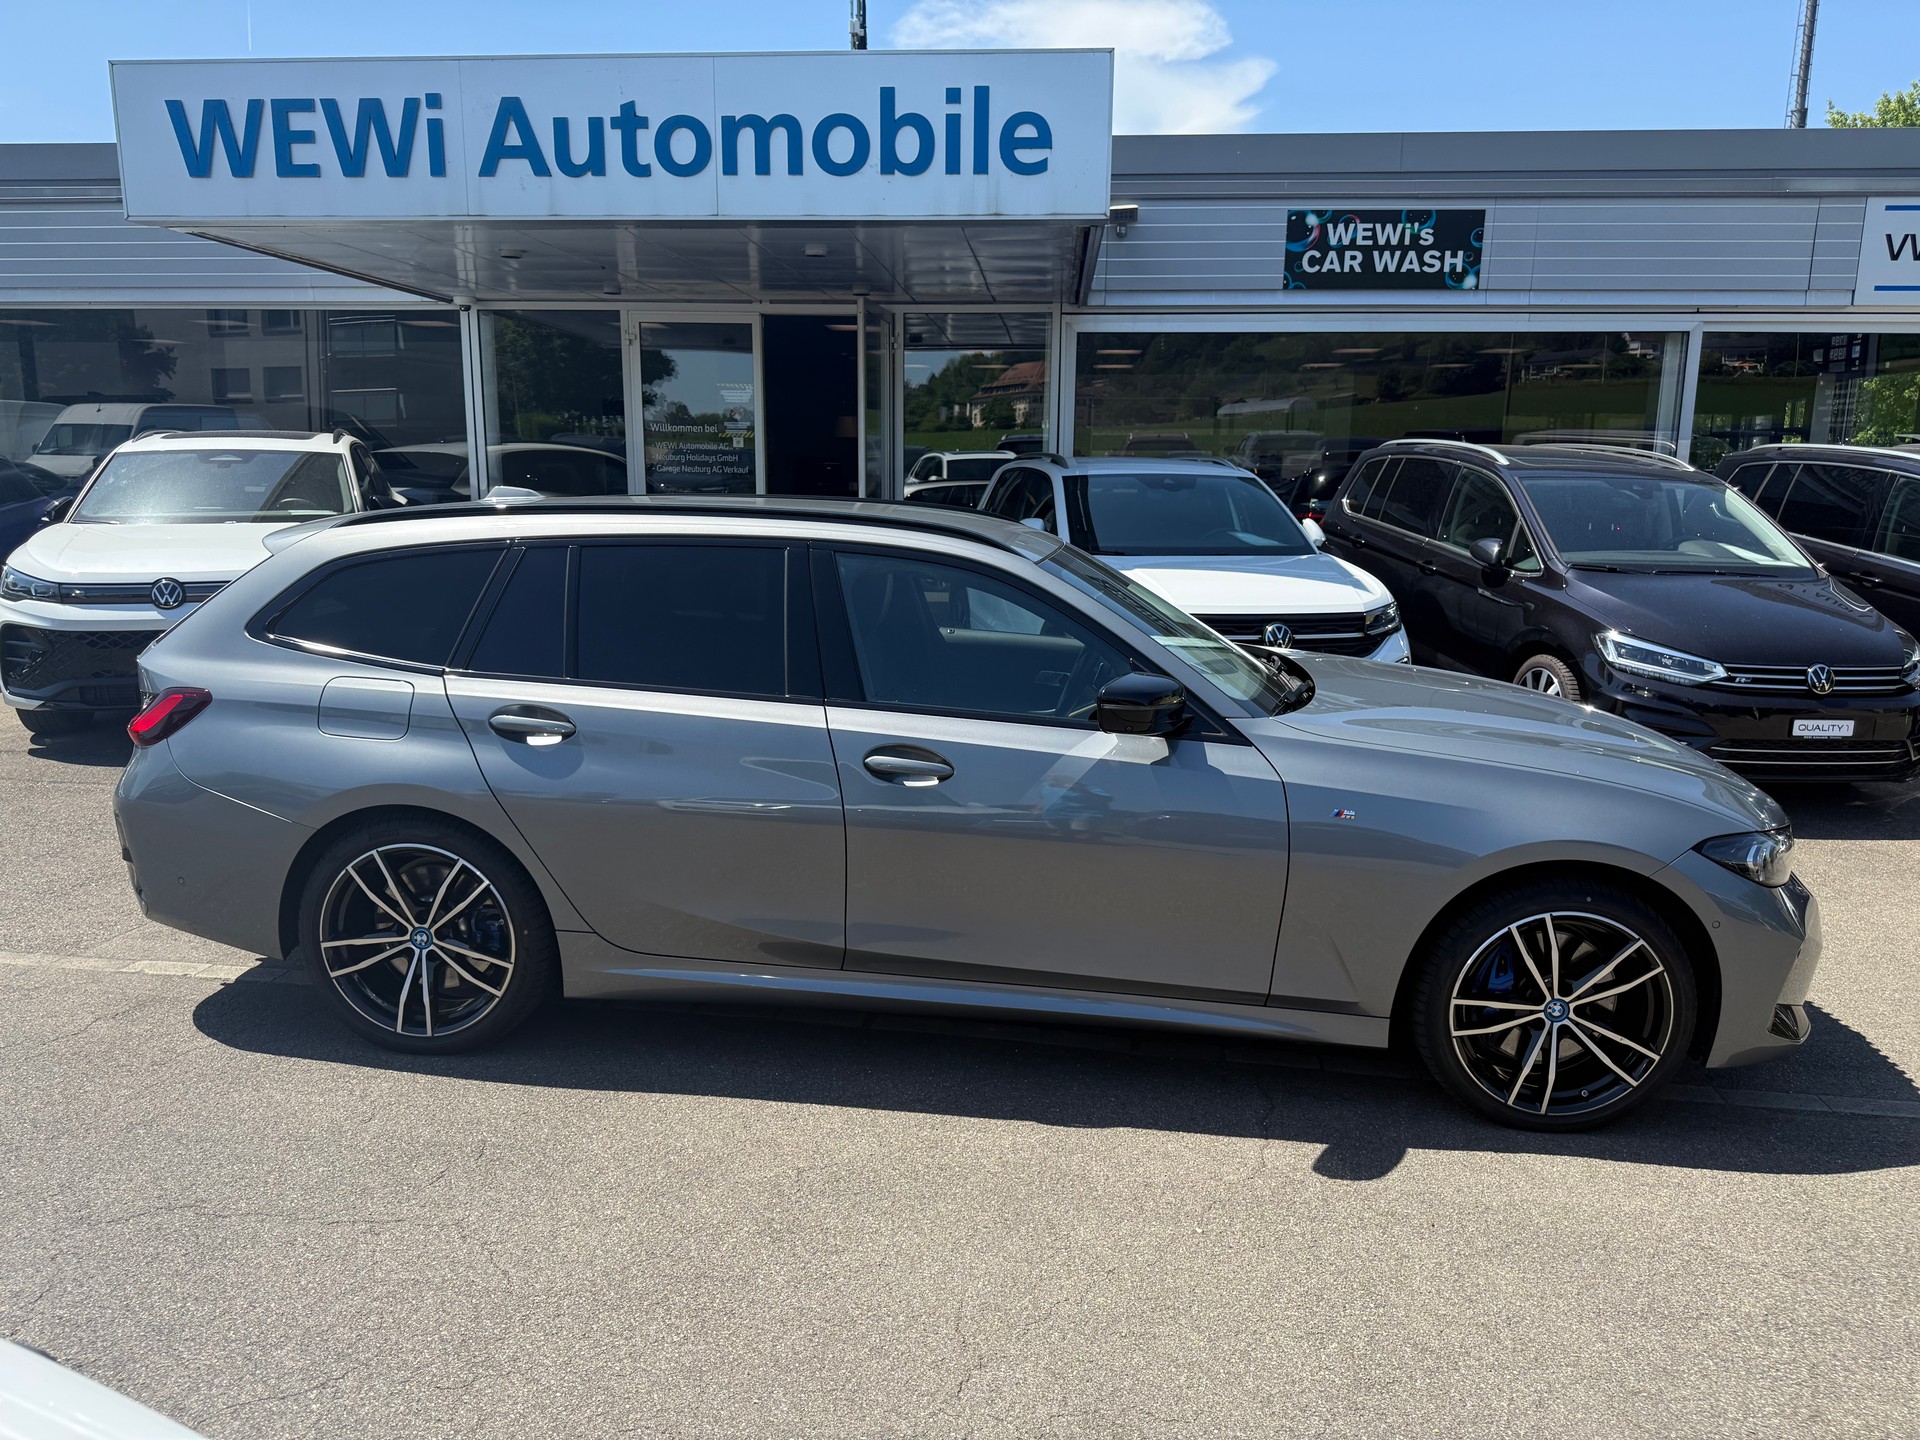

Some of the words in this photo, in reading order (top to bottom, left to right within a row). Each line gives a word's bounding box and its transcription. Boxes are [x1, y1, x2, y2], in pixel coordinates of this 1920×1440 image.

[164, 92, 446, 178] WEWi
[478, 85, 1053, 178] Automobile
[1326, 222, 1435, 246] WEWi's
[1302, 250, 1363, 273] CAR
[1373, 250, 1464, 273] WASH
[650, 422, 703, 433] Willkommen
[704, 423, 718, 433] bei
[655, 442, 678, 450] WEWi
[679, 442, 719, 450] Automobile
[719, 442, 729, 450] AG
[656, 454, 685, 462] Neuburg
[686, 454, 716, 463] Holidays
[717, 454, 738, 462] GmbH
[656, 465, 681, 474] Garage
[681, 465, 711, 474] Neuburg
[723, 466, 749, 474] Verkauf
[1798, 724, 1844, 732] QUALITY
[1845, 724, 1850, 732] 1
